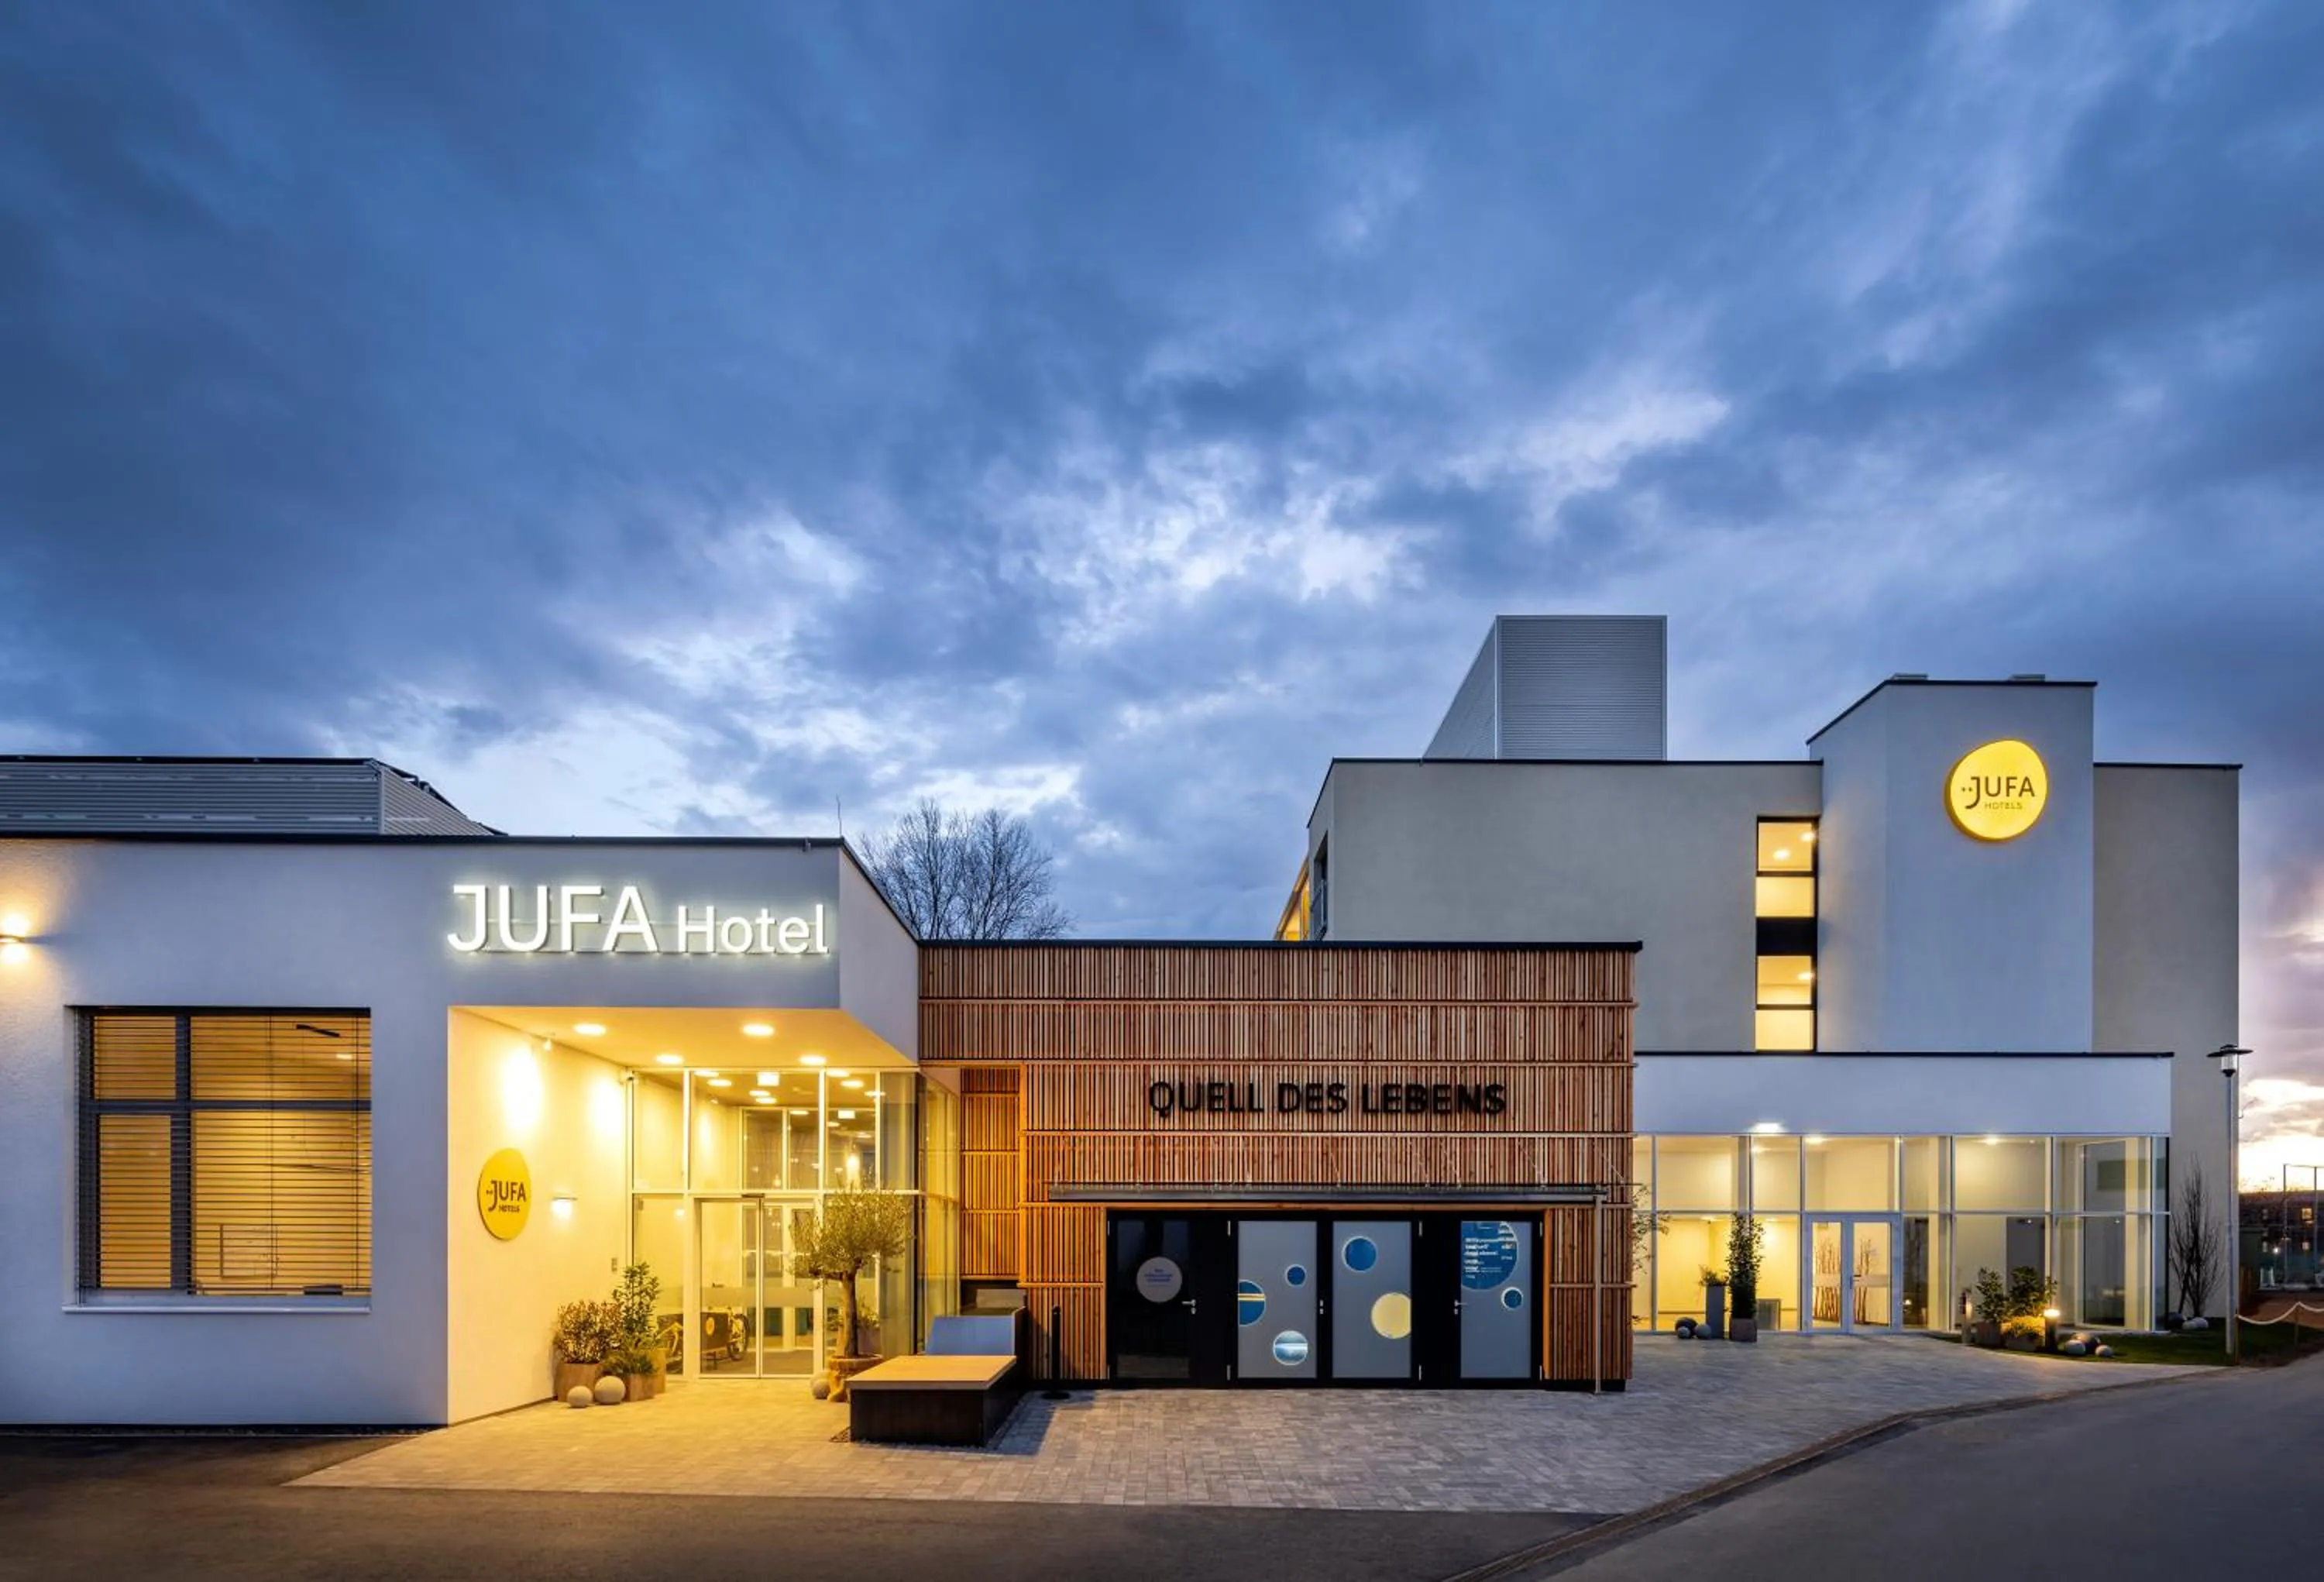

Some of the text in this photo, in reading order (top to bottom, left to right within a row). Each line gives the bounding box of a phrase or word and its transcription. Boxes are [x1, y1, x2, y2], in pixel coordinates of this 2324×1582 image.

[1965, 776, 2035, 810] JUFA
[1984, 801, 2023, 810] HOTELS
[447, 884, 829, 954] JUFA Hotel
[1150, 1082, 1505, 1117] QUELL DES LEBENS
[487, 1179, 526, 1212] JUFA
